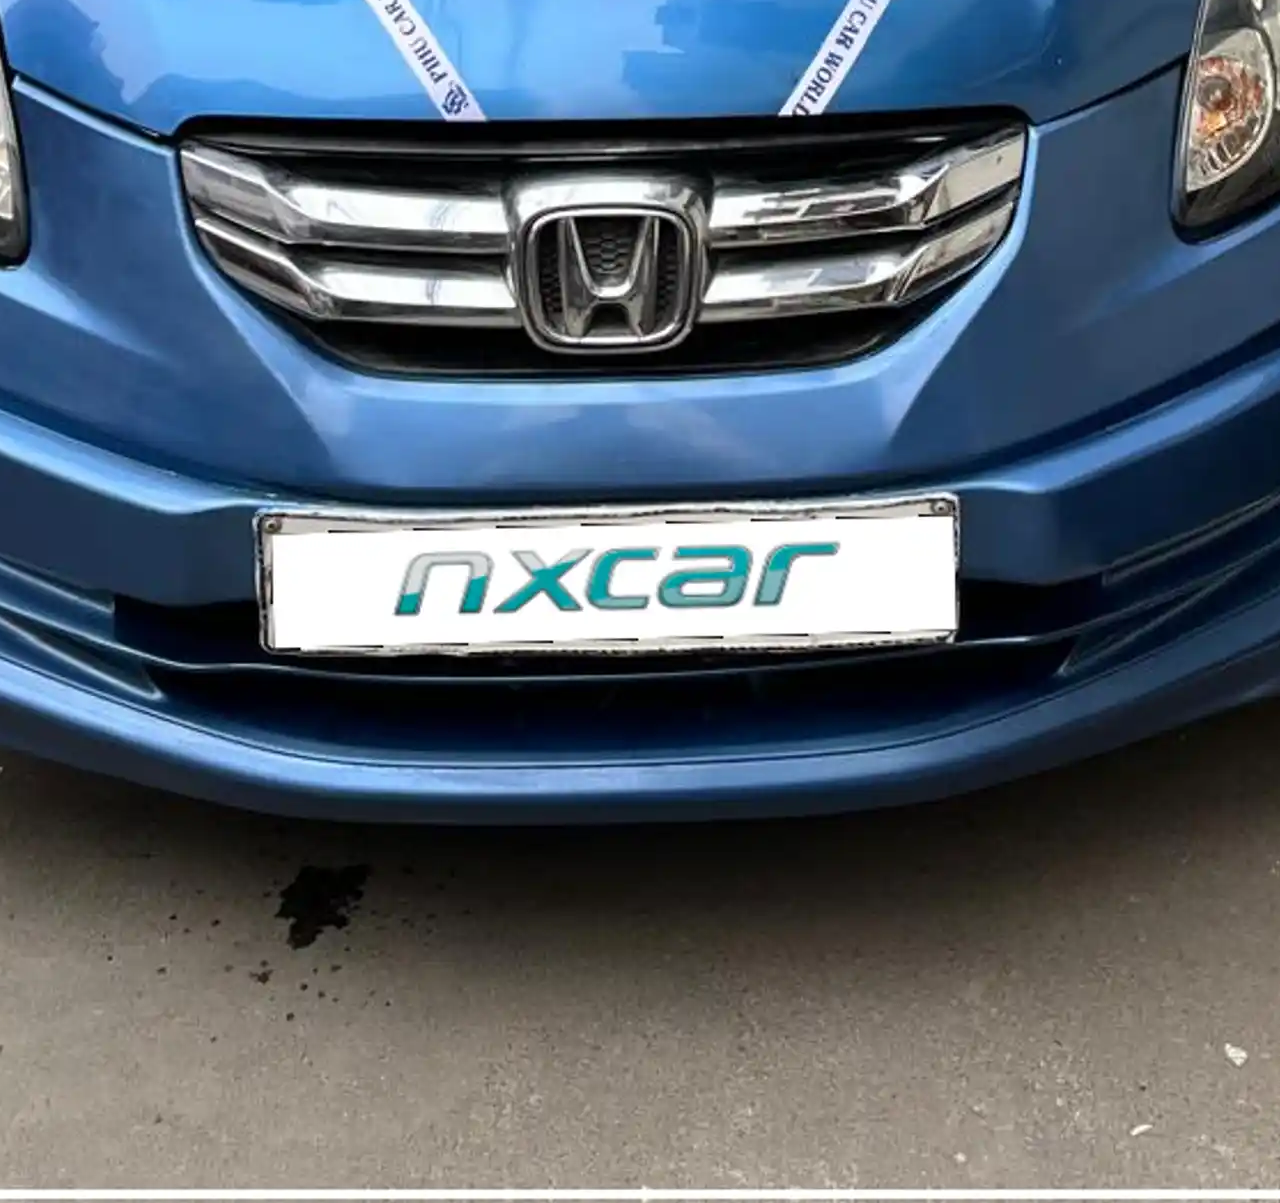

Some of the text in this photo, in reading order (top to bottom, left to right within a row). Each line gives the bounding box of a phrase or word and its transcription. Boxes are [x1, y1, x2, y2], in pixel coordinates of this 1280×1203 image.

[384, 0, 417, 36] CAR
[835, 10, 868, 50] CAR
[409, 36, 449, 84] PIHU
